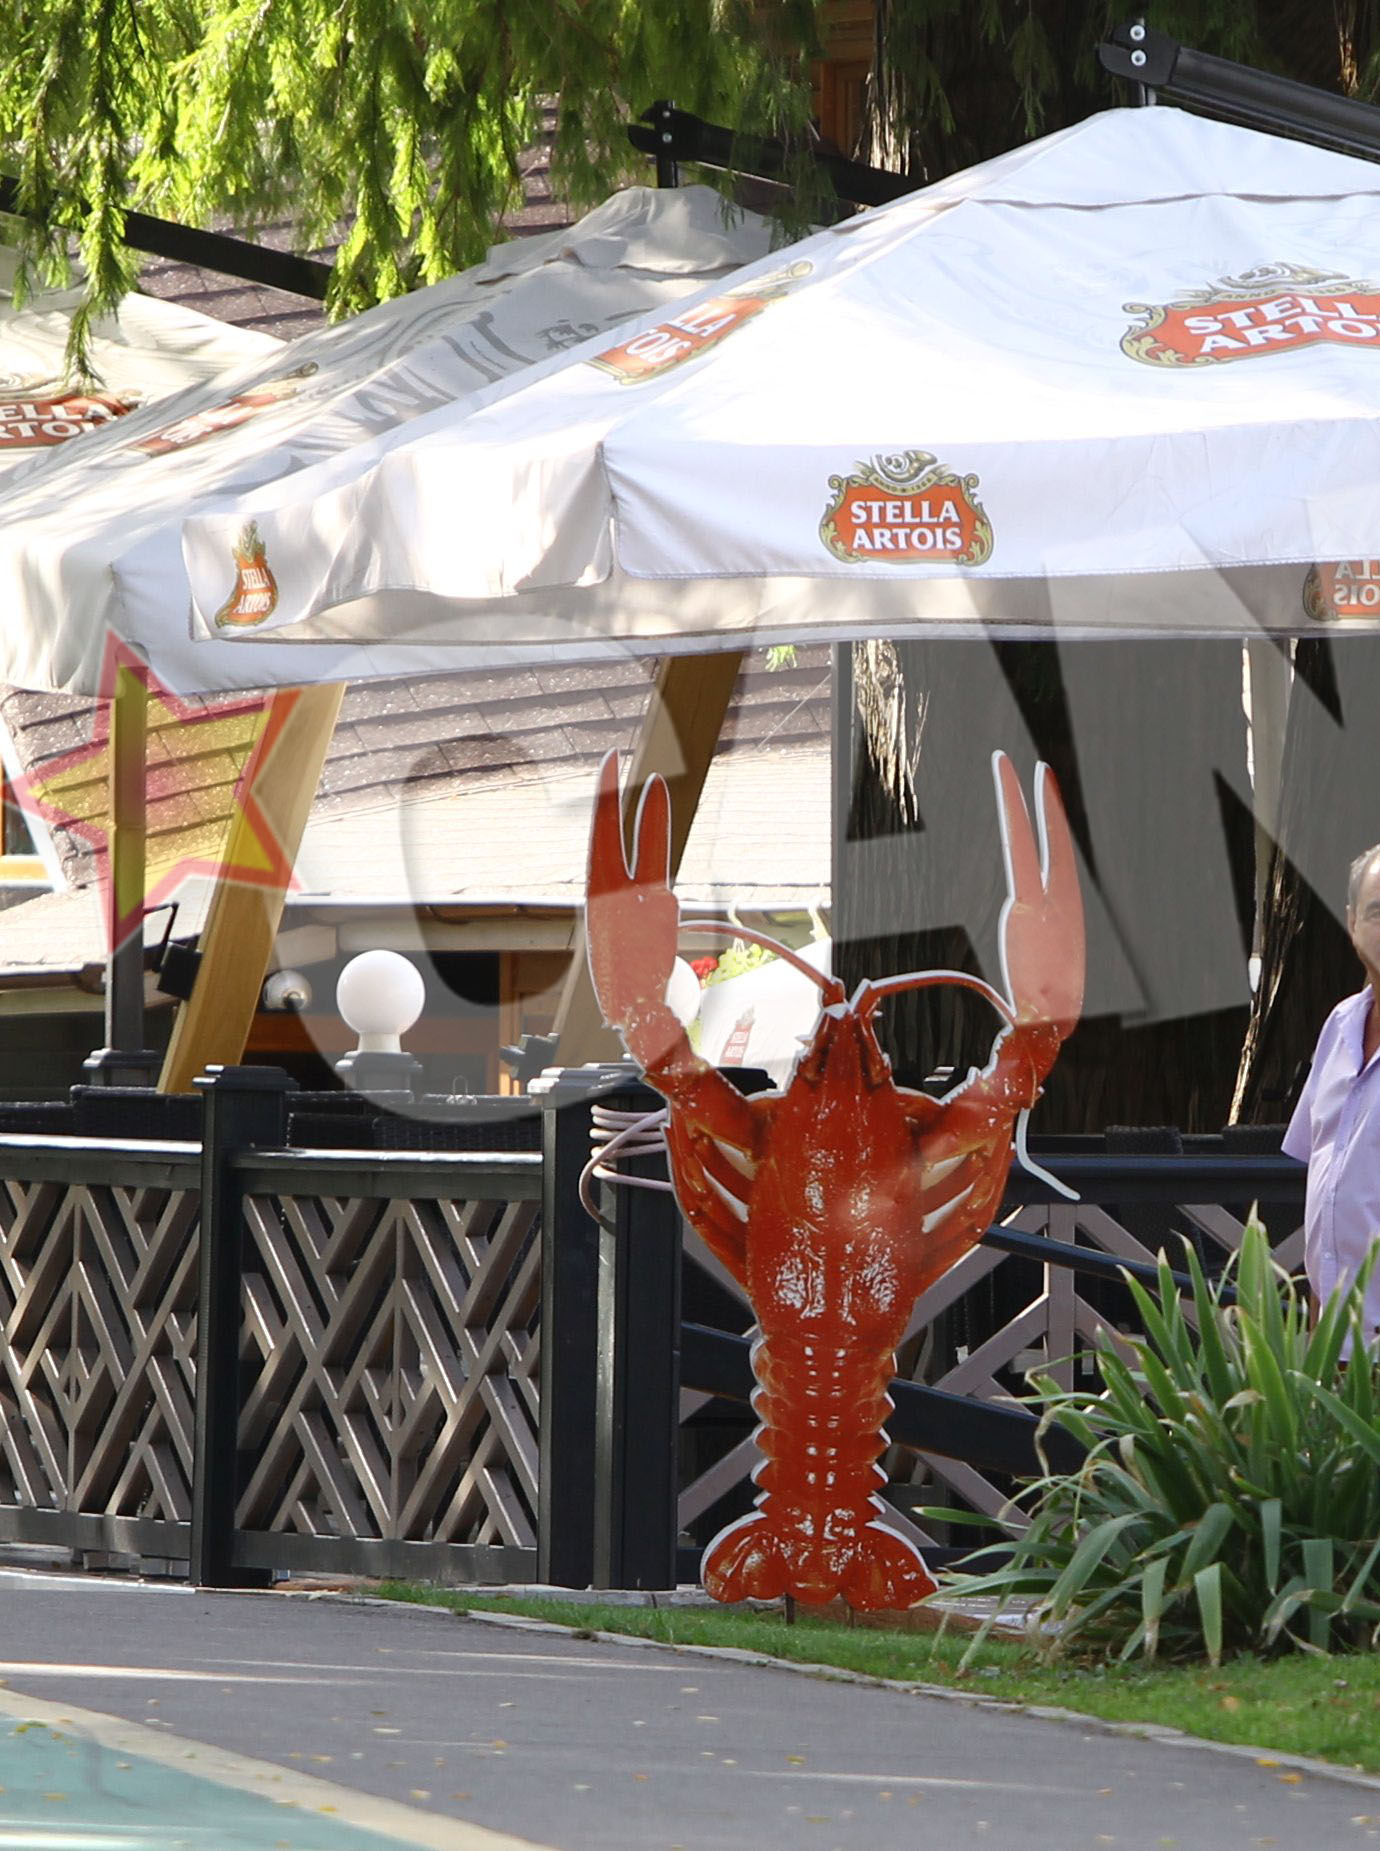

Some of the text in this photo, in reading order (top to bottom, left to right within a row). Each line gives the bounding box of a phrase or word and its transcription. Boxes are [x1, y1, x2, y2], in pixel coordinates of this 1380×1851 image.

[0, 403, 119, 422] ELLA
[850, 500, 961, 525] STELLA
[852, 527, 963, 550] ARTOIS
